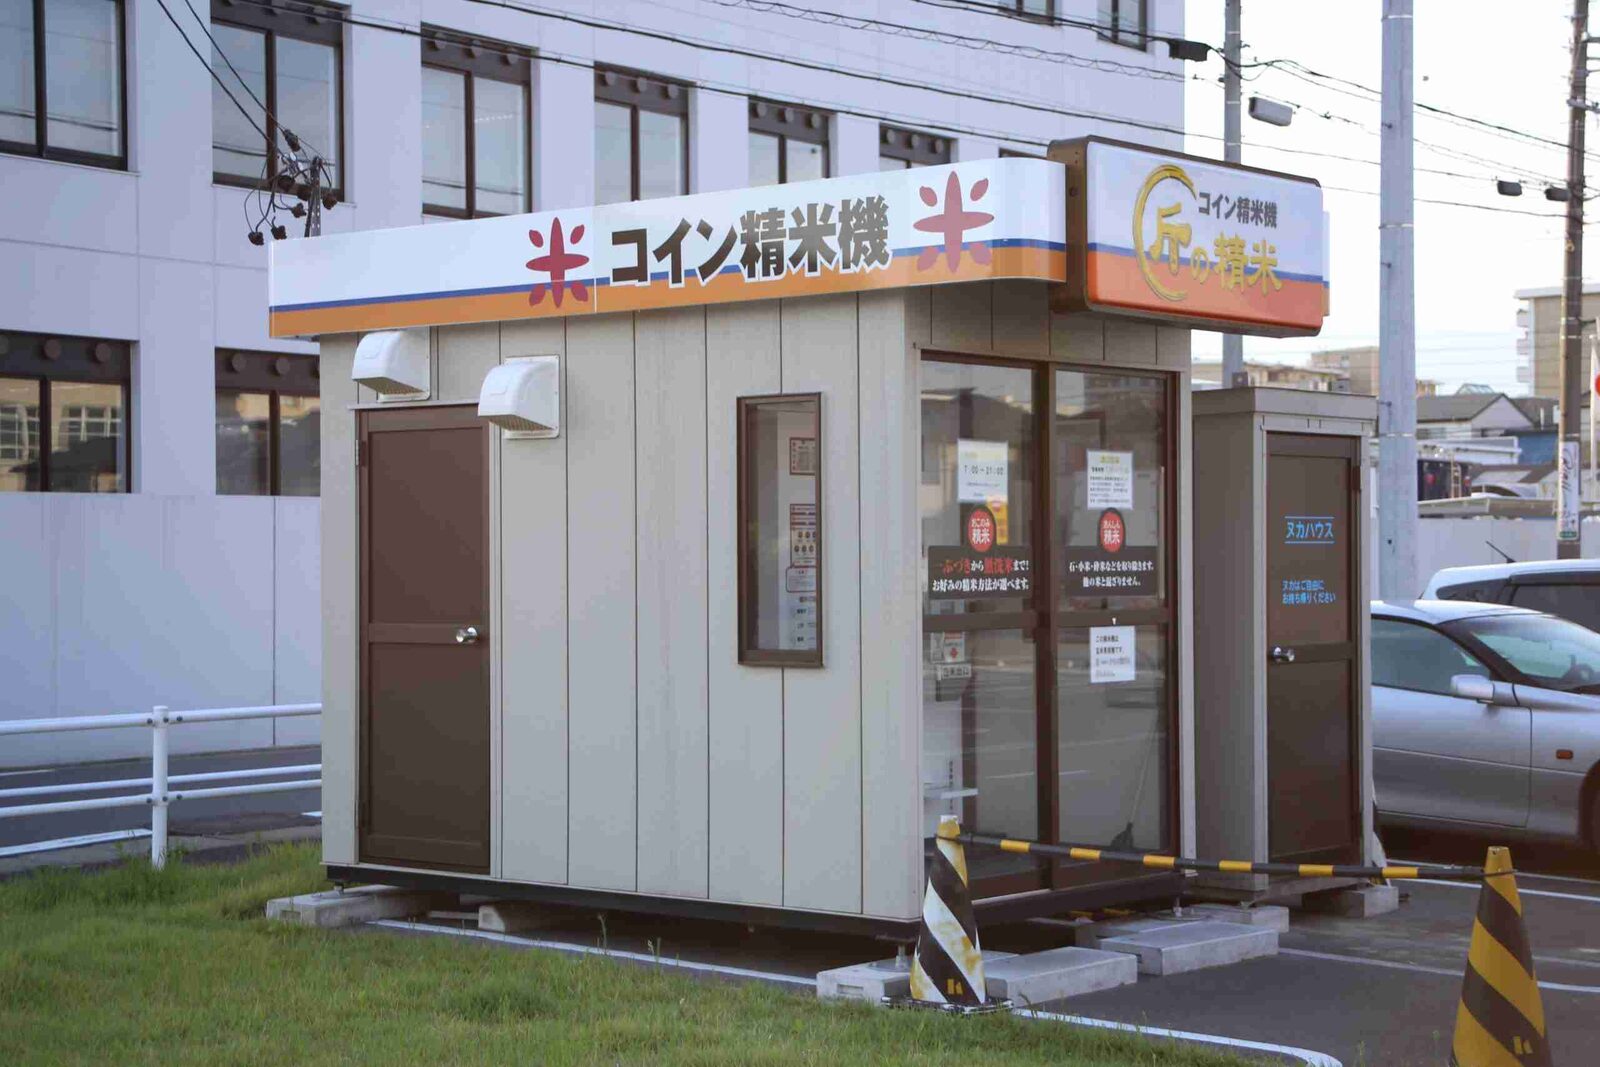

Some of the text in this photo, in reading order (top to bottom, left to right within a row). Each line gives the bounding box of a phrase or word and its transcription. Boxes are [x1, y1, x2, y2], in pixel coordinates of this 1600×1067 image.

[1198, 191, 1278, 229] コイン精米機
[610, 194, 892, 287] コイン精米機
[1286, 521, 1334, 539] ヌカハウス
